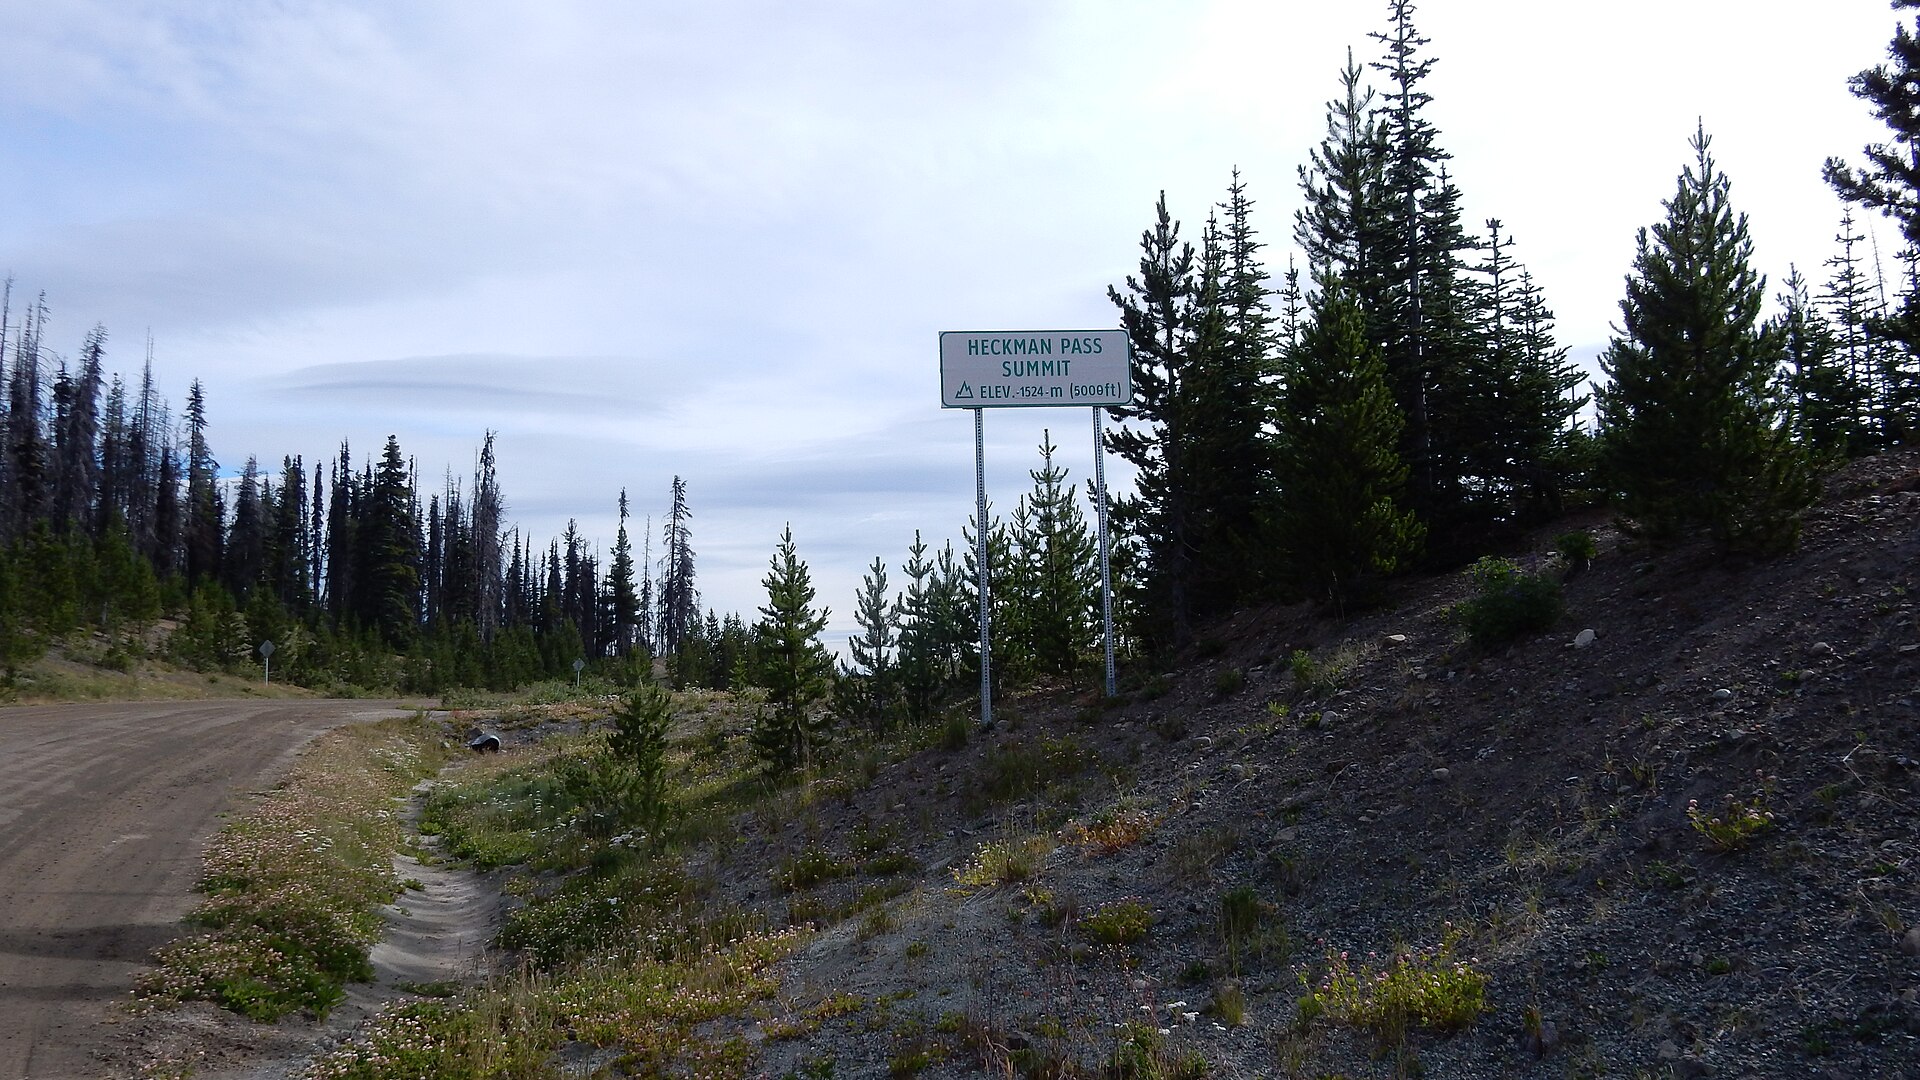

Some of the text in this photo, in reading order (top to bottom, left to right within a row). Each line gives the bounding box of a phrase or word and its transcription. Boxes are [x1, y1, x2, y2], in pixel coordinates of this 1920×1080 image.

[968, 338, 1103, 355] HECKMAN PASS
[1002, 360, 1071, 377] SUMMIT
[980, 385, 1015, 399] ELEV.
[1070, 381, 1122, 399] (5000ft)
